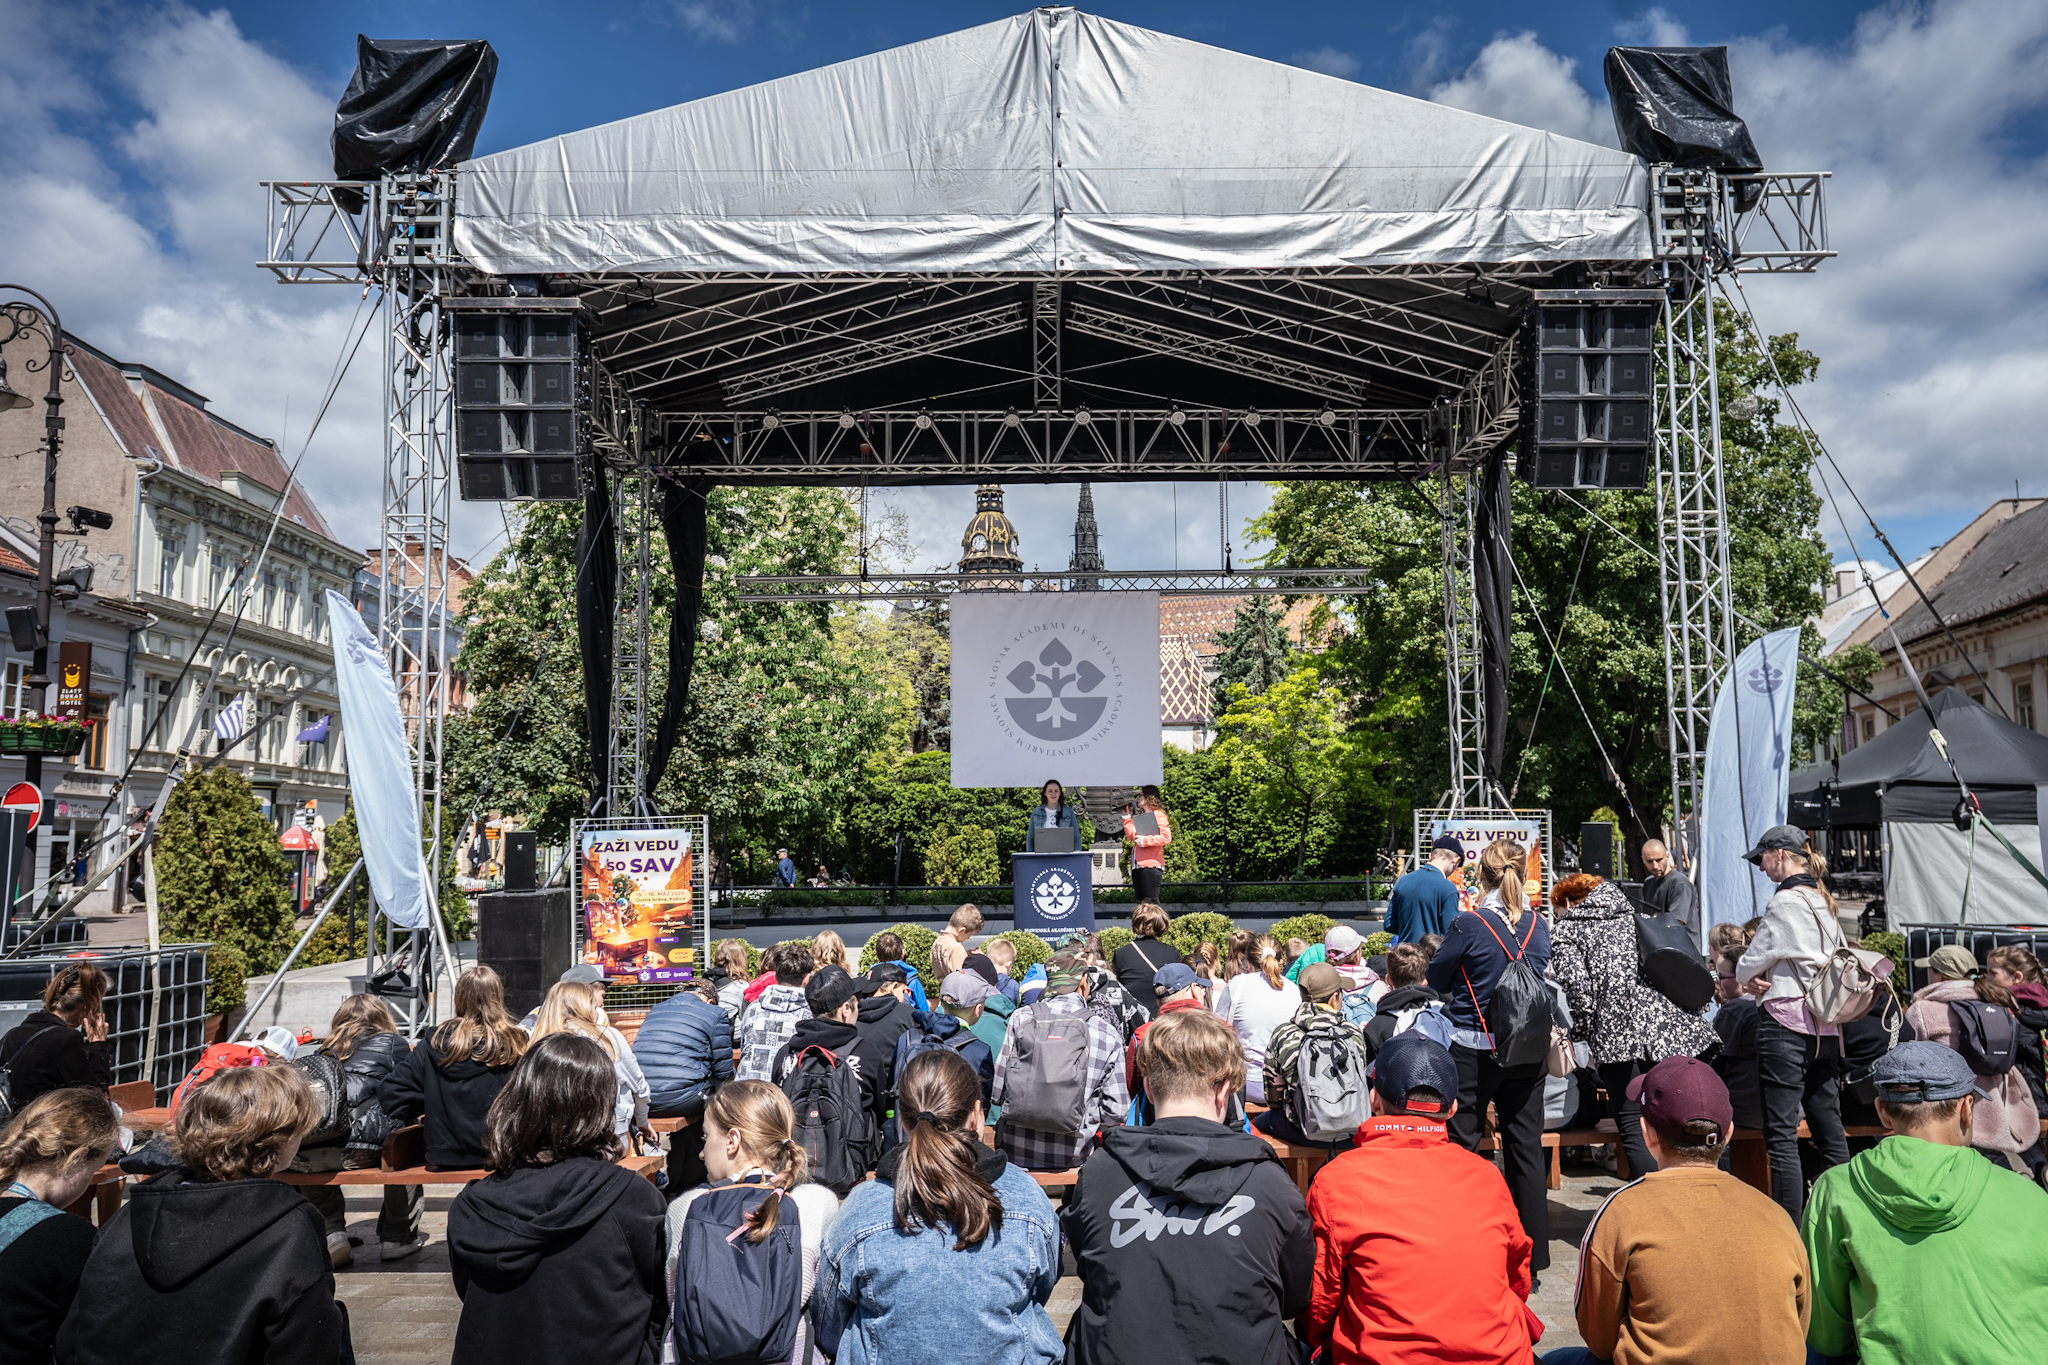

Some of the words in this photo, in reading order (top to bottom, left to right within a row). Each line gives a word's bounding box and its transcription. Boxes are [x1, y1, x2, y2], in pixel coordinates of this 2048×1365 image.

[989, 645, 1011, 687] SLOVAK
[1013, 622, 1066, 644] ACADEMY
[1073, 625, 1087, 635] OF
[1090, 635, 1123, 687] SCIENCES
[990, 694, 1015, 738] SLOVACA
[1092, 692, 1123, 742] ACADEMIA
[1016, 737, 1090, 756] SCIENTIARUM
[594, 838, 630, 853] ZAŽI
[634, 840, 679, 851] VEDU
[1485, 831, 1528, 841] VEDU
[606, 861, 626, 871] SO
[630, 857, 676, 873] SAV
